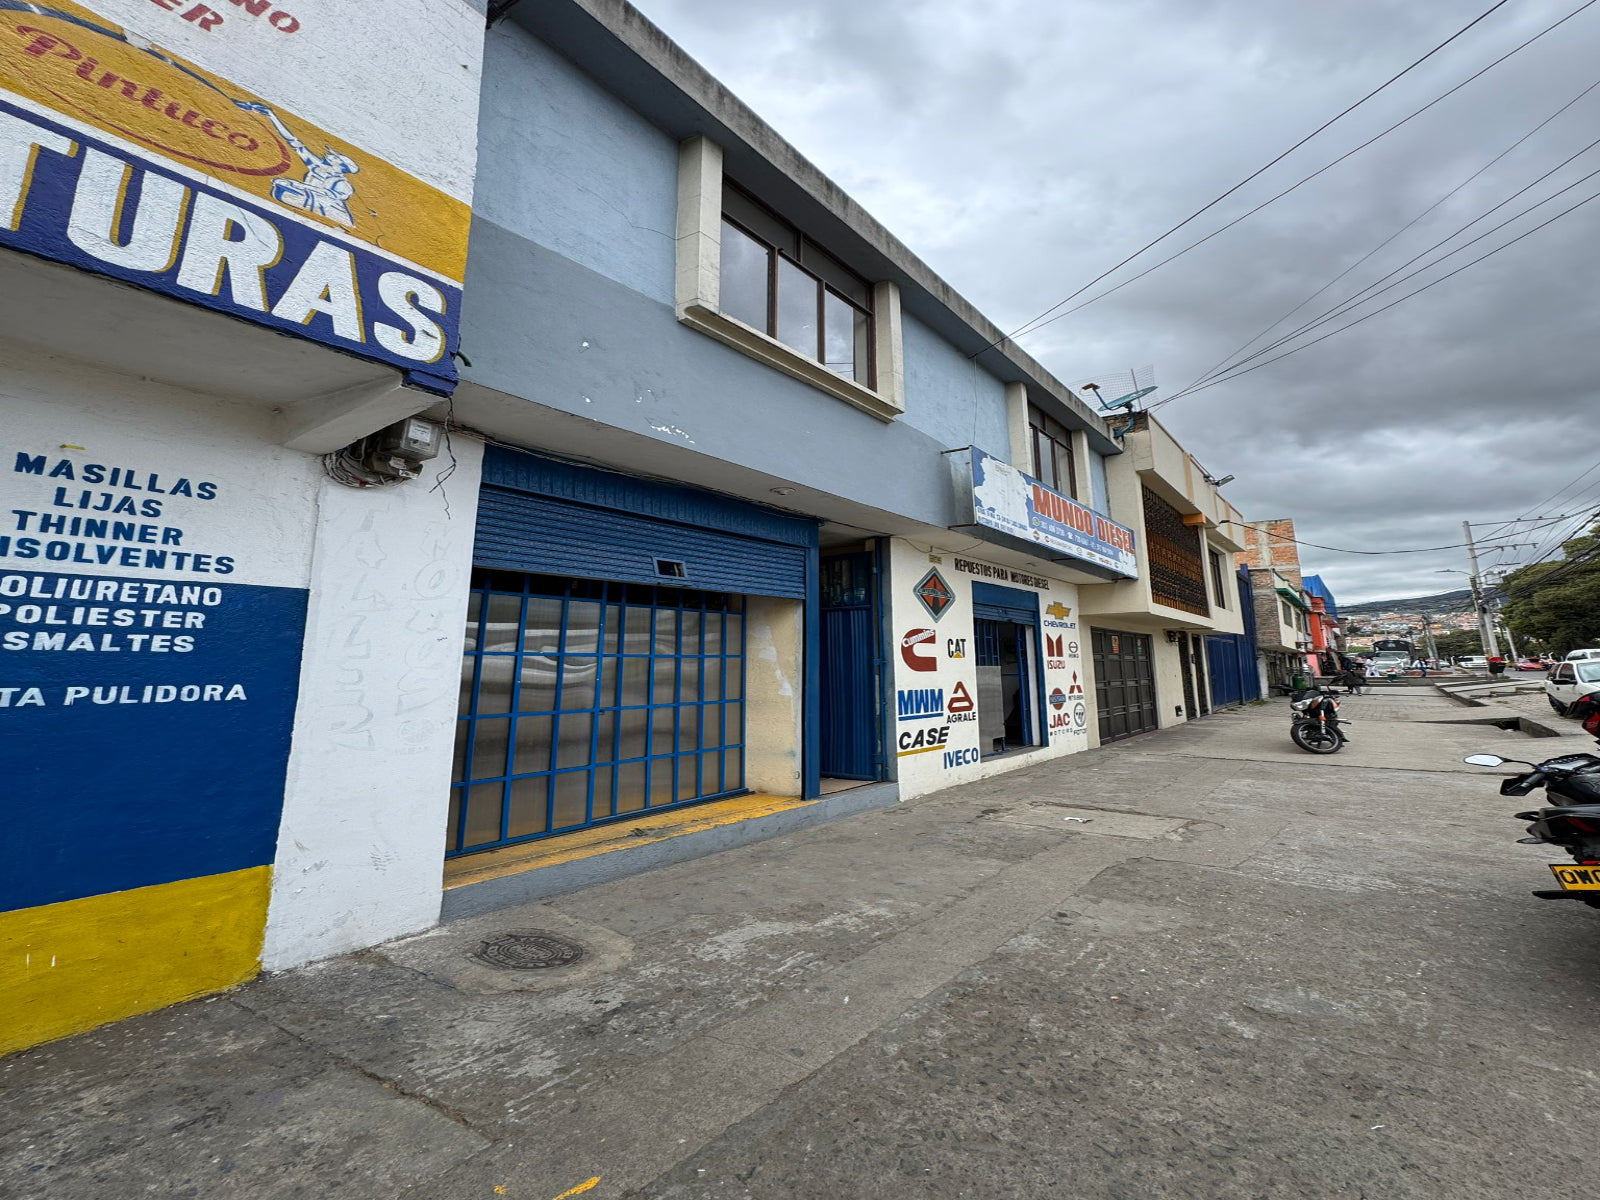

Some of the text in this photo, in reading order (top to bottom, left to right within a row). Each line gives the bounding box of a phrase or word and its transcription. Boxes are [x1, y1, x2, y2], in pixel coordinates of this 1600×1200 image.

[16, 25, 260, 152] Pintuco
[0, 108, 447, 364] TURAS
[14, 452, 218, 500] MASILLAS
[53, 486, 164, 518] LIJAS
[12, 509, 184, 546] THINNER
[1032, 484, 1095, 537] MUNDO
[1097, 517, 1136, 555] DIESEL
[954, 557, 992, 578] REPUESTOS
[992, 566, 1009, 581] PARA
[1010, 571, 1034, 586] MOTORES
[1043, 620, 1076, 629] CHEVROLET
[2, 631, 196, 653] SMALTES
[947, 638, 967, 659] CAT
[1047, 659, 1066, 670] ISUZU
[63, 683, 248, 707] PULIDORA
[898, 688, 943, 715] MWM
[946, 711, 977, 724] AGRALE
[1049, 712, 1071, 729] JAC
[898, 726, 950, 750] CASE
[943, 747, 979, 770] IVECO
